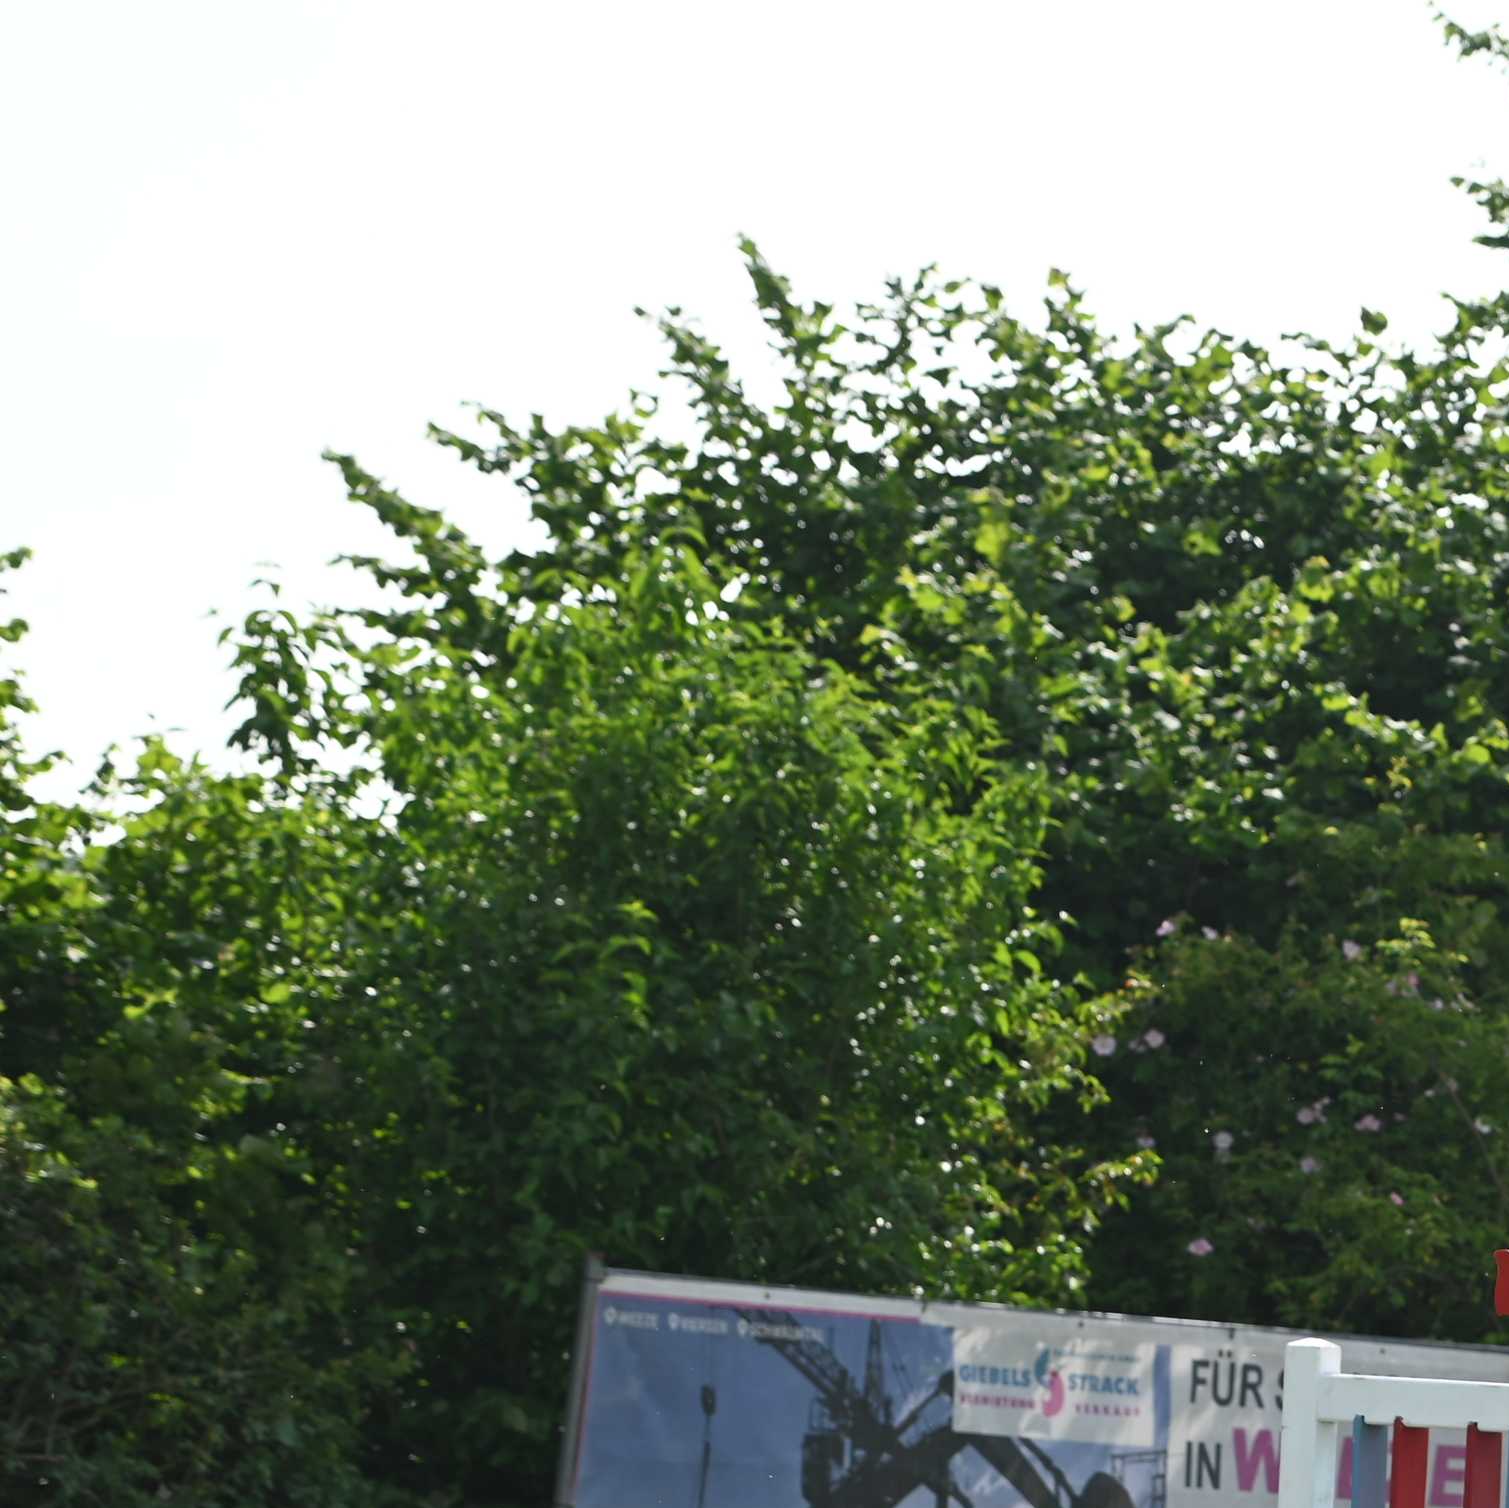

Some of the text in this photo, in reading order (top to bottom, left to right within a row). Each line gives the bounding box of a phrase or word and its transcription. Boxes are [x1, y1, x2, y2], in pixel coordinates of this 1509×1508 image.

[958, 1364, 1141, 1396] GIEBELS STRACK
[1190, 1349, 1264, 1409] FÜR
[1184, 1441, 1223, 1491] IN
